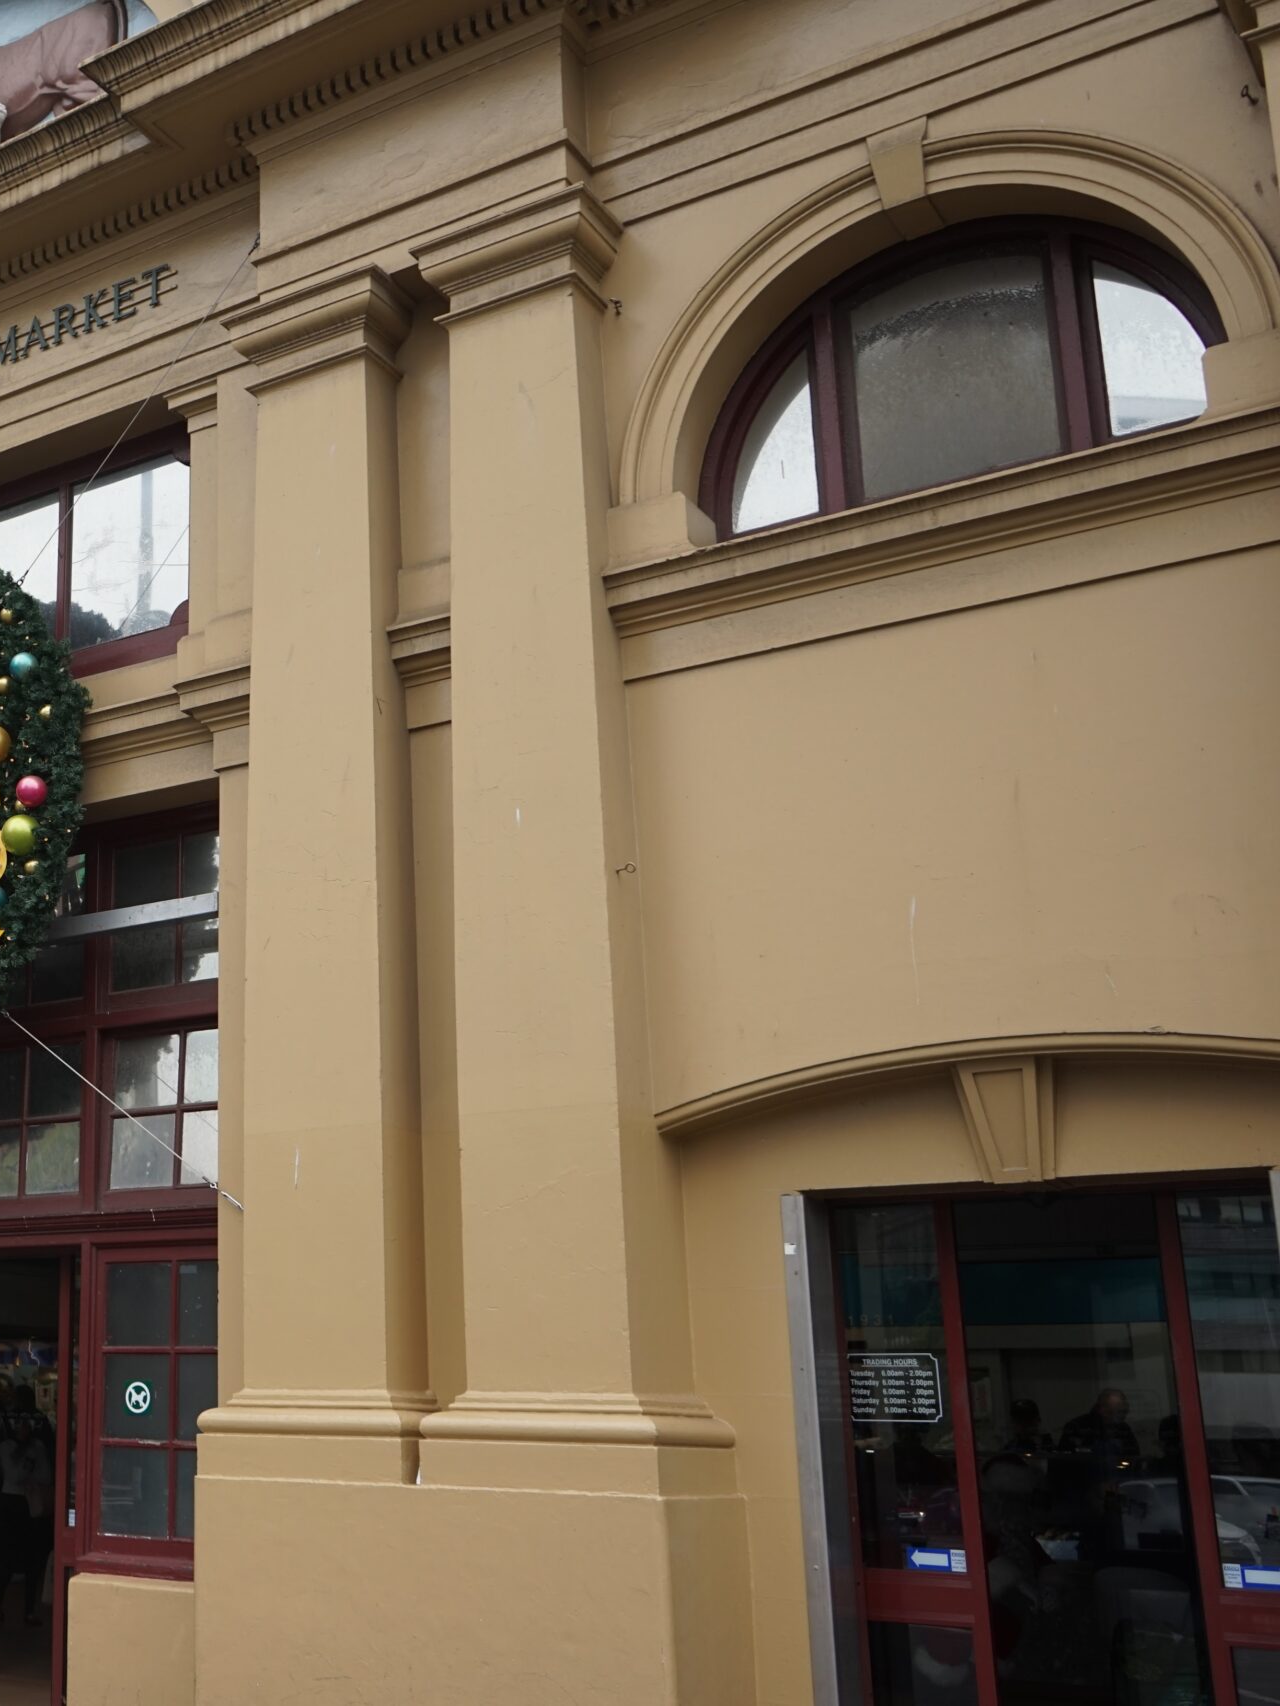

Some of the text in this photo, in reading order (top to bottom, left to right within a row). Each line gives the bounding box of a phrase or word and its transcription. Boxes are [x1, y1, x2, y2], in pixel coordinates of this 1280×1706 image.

[863, 1358, 918, 1366] TRADING HOURS
[851, 1370, 875, 1378] Tuesday
[851, 1379, 879, 1387] Thursday
[852, 1388, 870, 1396] Friday
[853, 1397, 879, 1405] Saturday
[853, 1406, 876, 1414] Sunday
